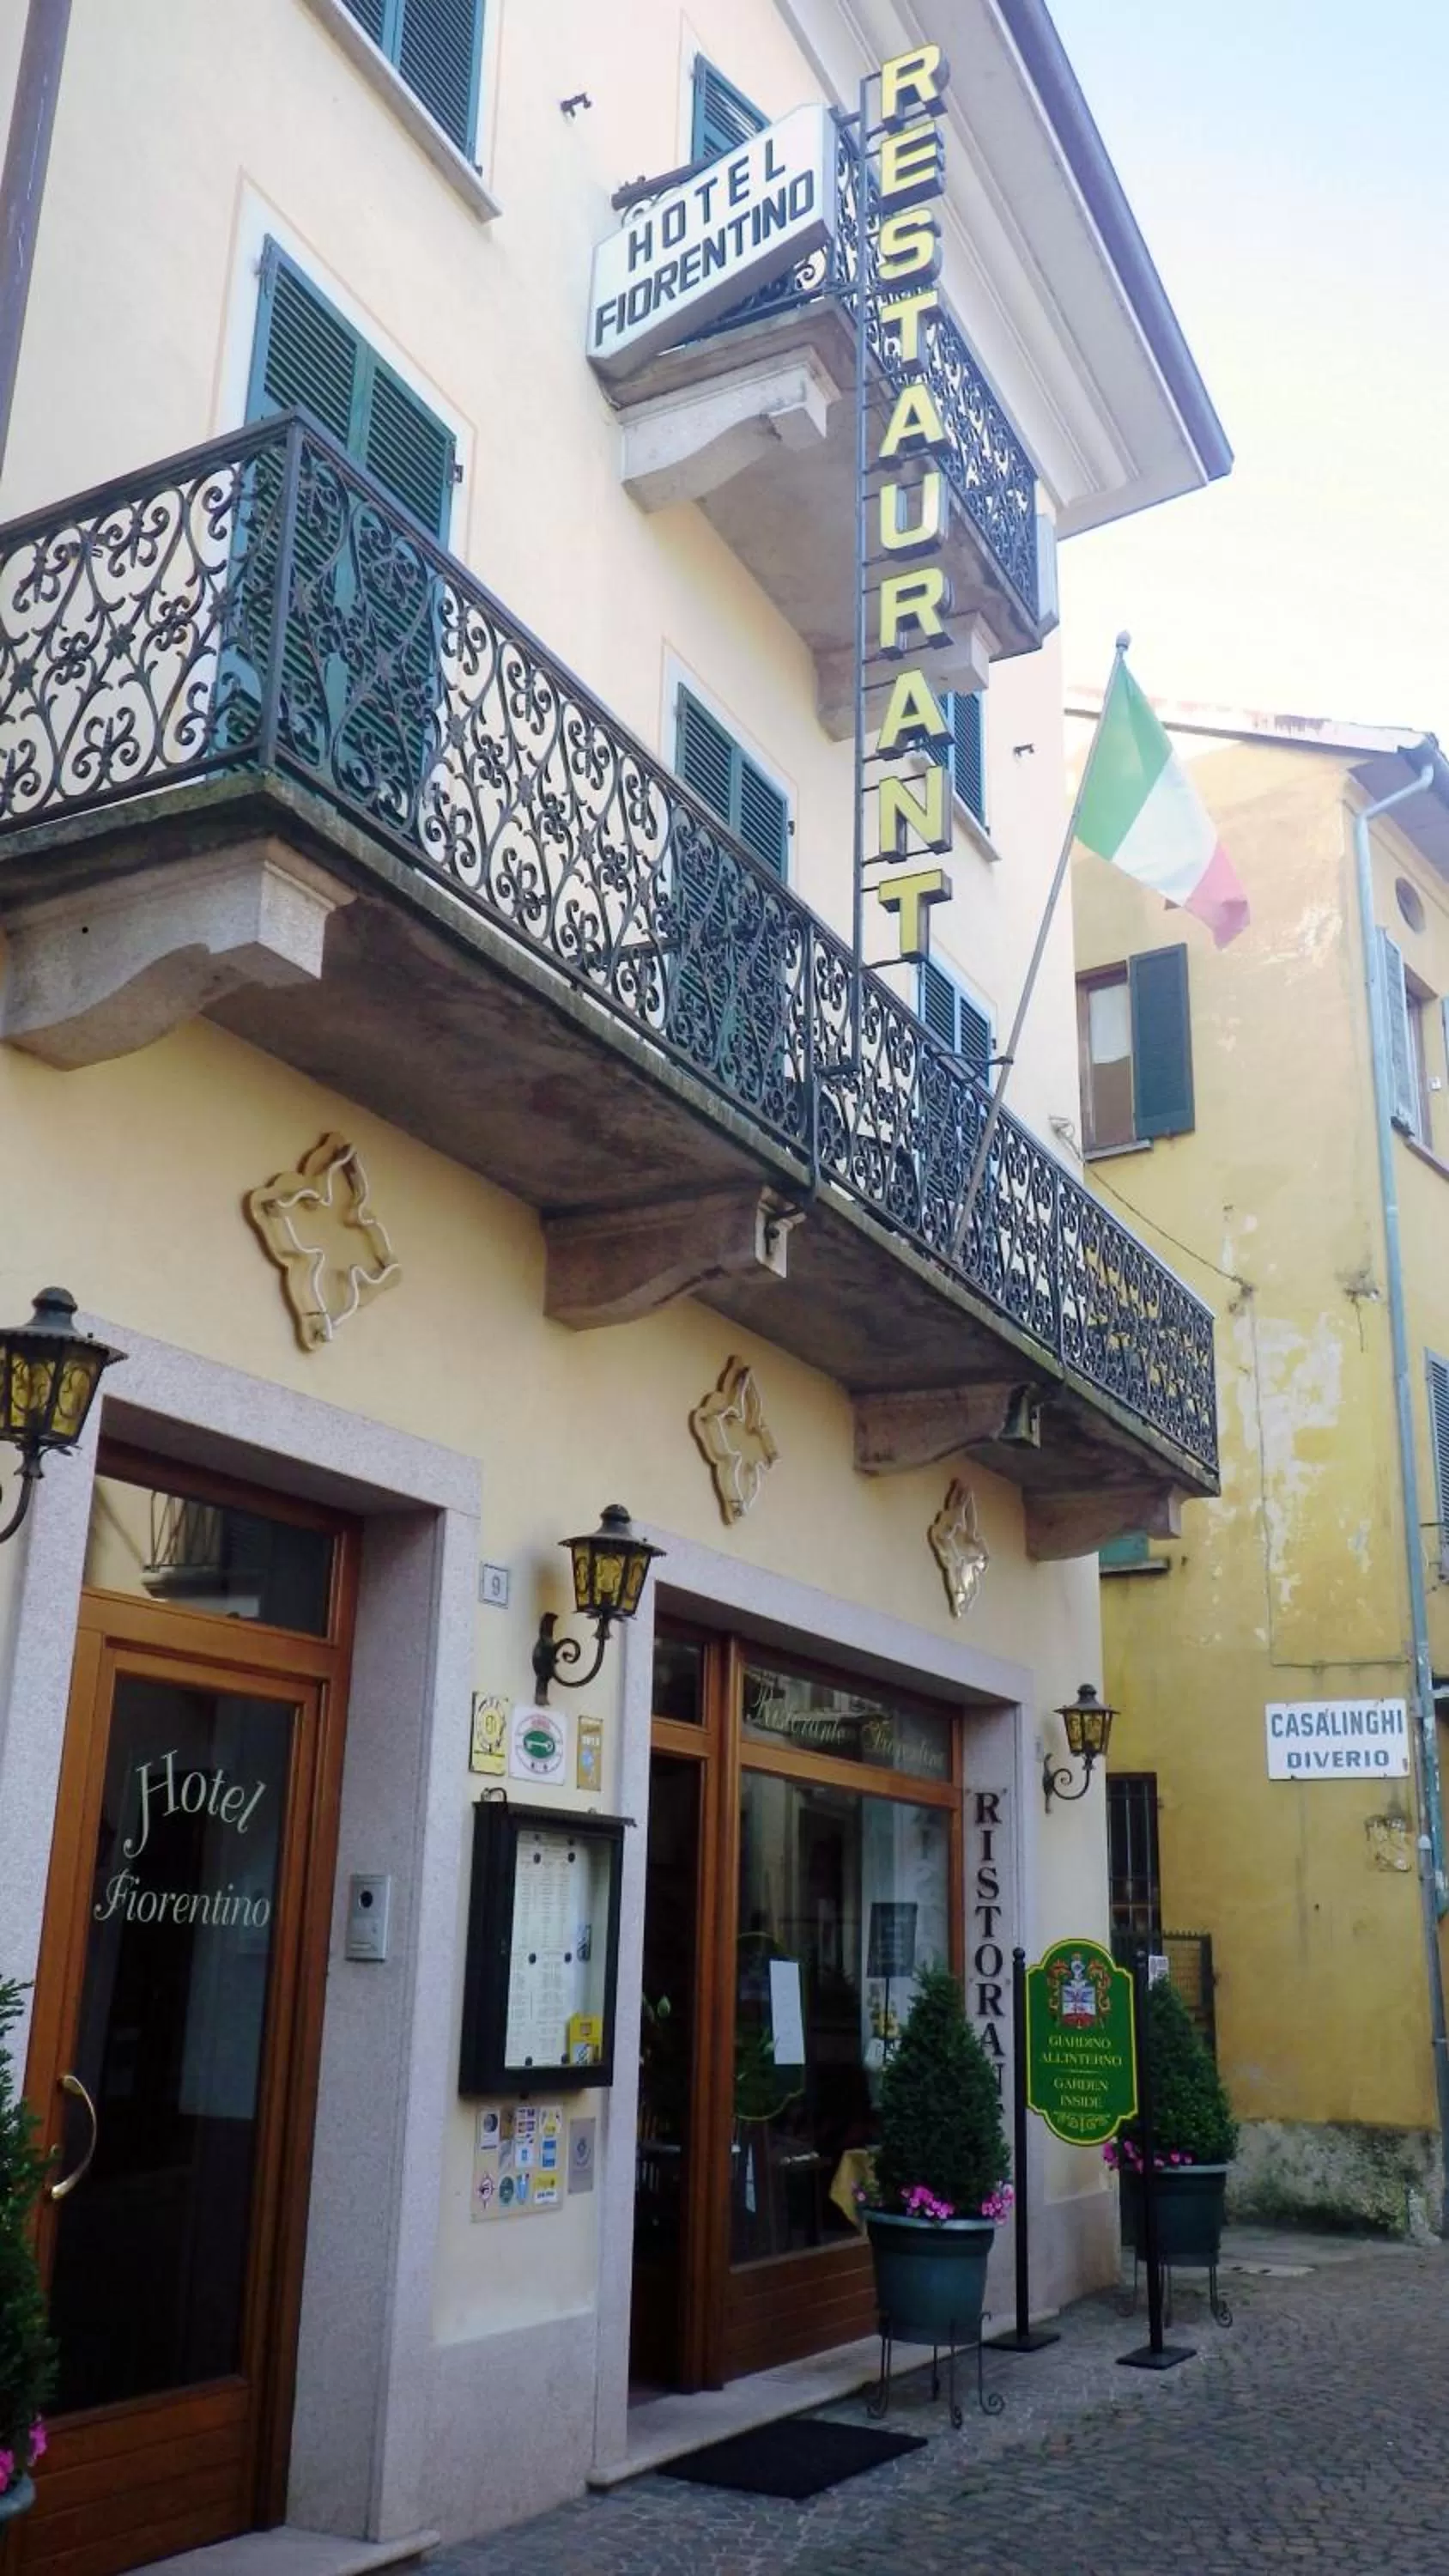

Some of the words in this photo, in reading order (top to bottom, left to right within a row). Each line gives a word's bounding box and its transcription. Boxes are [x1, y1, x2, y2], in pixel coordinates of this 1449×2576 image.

[627, 138, 786, 272] HOTEL
[594, 169, 815, 348] FIORENTINO
[877, 42, 950, 960] RESTAURANT
[1270, 1708, 1404, 1739] CASALINGHI
[1287, 1749, 1391, 1770] DIVERIO
[123, 1748, 267, 1859] Hotel
[93, 1868, 271, 1928] Fiorentino
[973, 1791, 1008, 2138] RISTORA
[1047, 2034, 1113, 2049] GIARDINO
[1052, 2077, 1109, 2092] GARDEN
[1059, 2094, 1105, 2110] INSIDE
